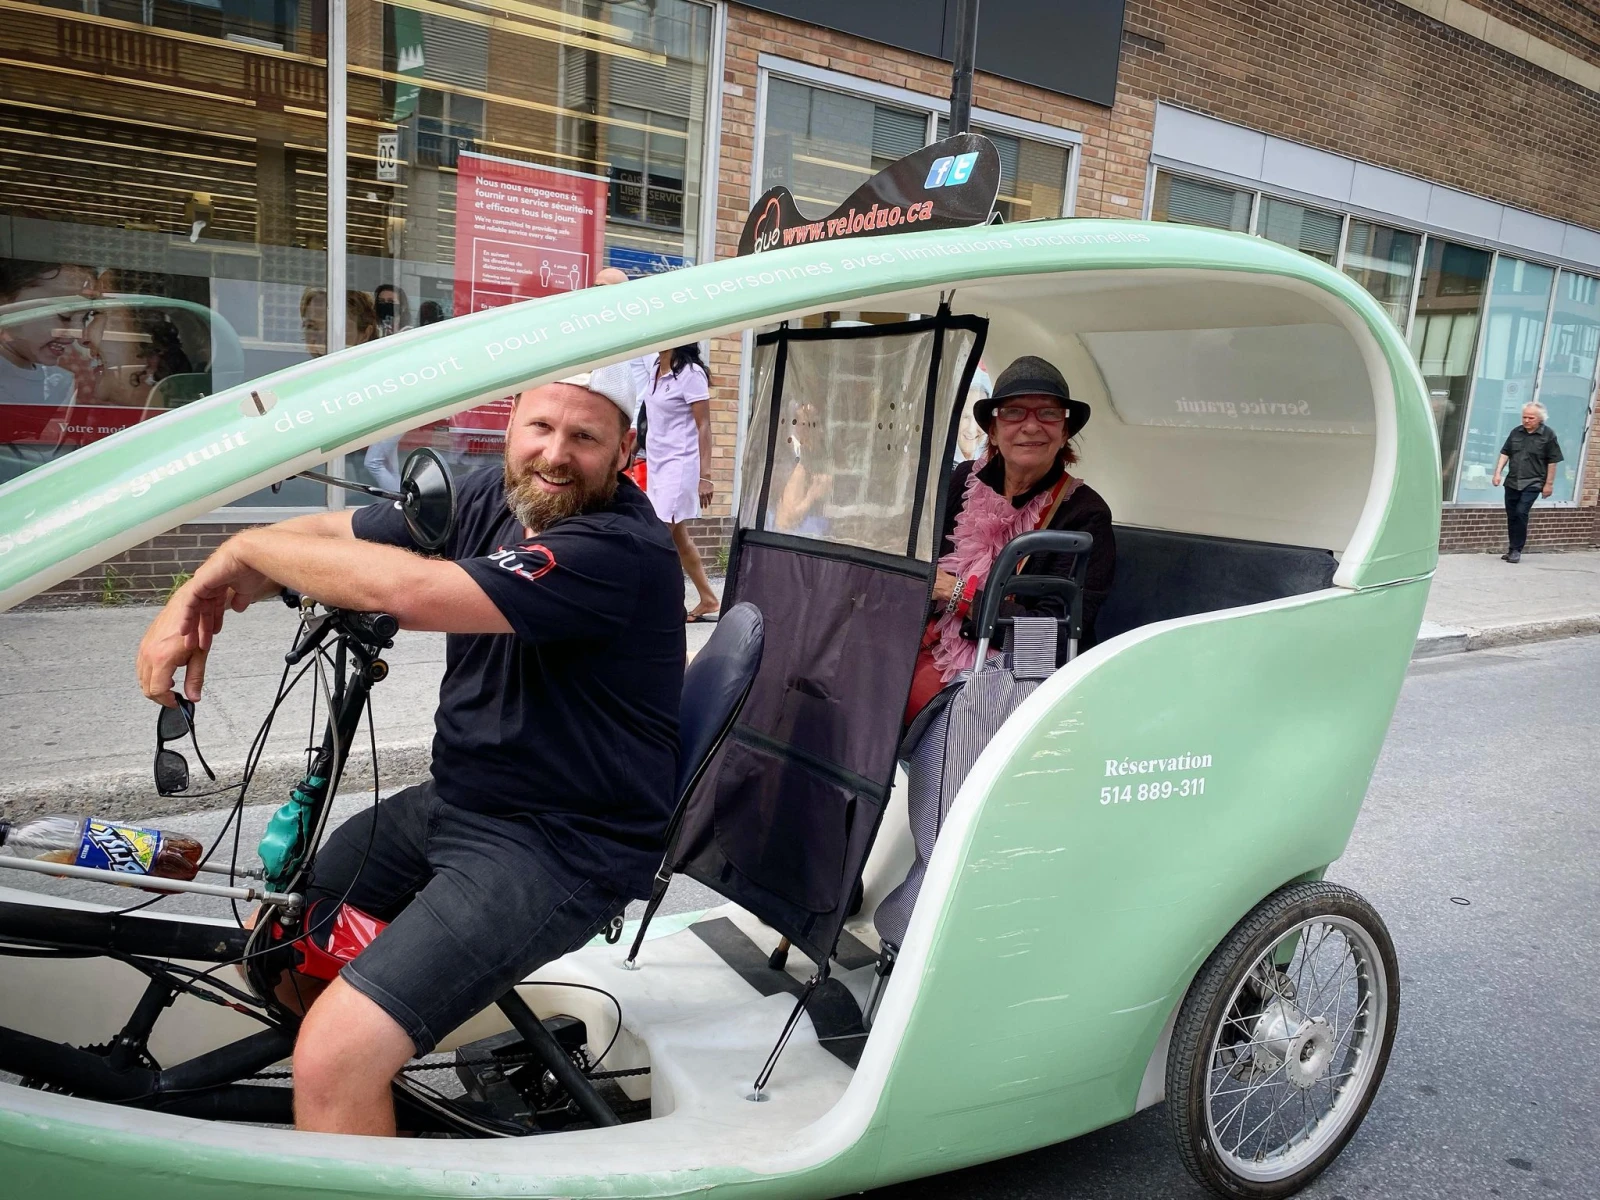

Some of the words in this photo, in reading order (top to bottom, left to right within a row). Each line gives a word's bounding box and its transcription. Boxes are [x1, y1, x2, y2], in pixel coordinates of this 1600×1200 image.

[475, 176, 499, 188] Nous
[501, 182, 522, 192] nous
[523, 185, 569, 201] engageons
[571, 192, 577, 201] à
[475, 188, 505, 201] fournir
[507, 194, 518, 202] un
[521, 195, 550, 208] service
[551, 199, 594, 215] sécuritaire
[475, 201, 484, 209] et
[486, 203, 520, 215] efficace
[521, 208, 539, 218] tous
[541, 210, 553, 219] les
[554, 213, 577, 224] jours.
[474, 214, 491, 223] We're
[492, 217, 524, 228] committed
[532, 223, 558, 235] providing
[559, 227, 570, 235] safe
[487, 225, 507, 233] reliable
[508, 227, 527, 236] service
[528, 231, 543, 240] every
[544, 233, 557, 242] day.
[783, 200, 934, 246] www.veloduo.ca
[129, 429, 250, 497] gratuit
[274, 409, 315, 433] de
[485, 325, 551, 360] pour
[560, 295, 664, 336] aîné(e)s
[671, 285, 699, 304] et
[703, 259, 834, 299] personnes
[841, 251, 895, 270] avec
[900, 234, 1013, 261] limitations
[1017, 230, 1151, 250] fonctionnelles
[58, 422, 93, 434] Votre
[1104, 751, 1212, 777] Réservation
[1100, 784, 1132, 805] 514
[1137, 777, 1205, 801] 889-311
